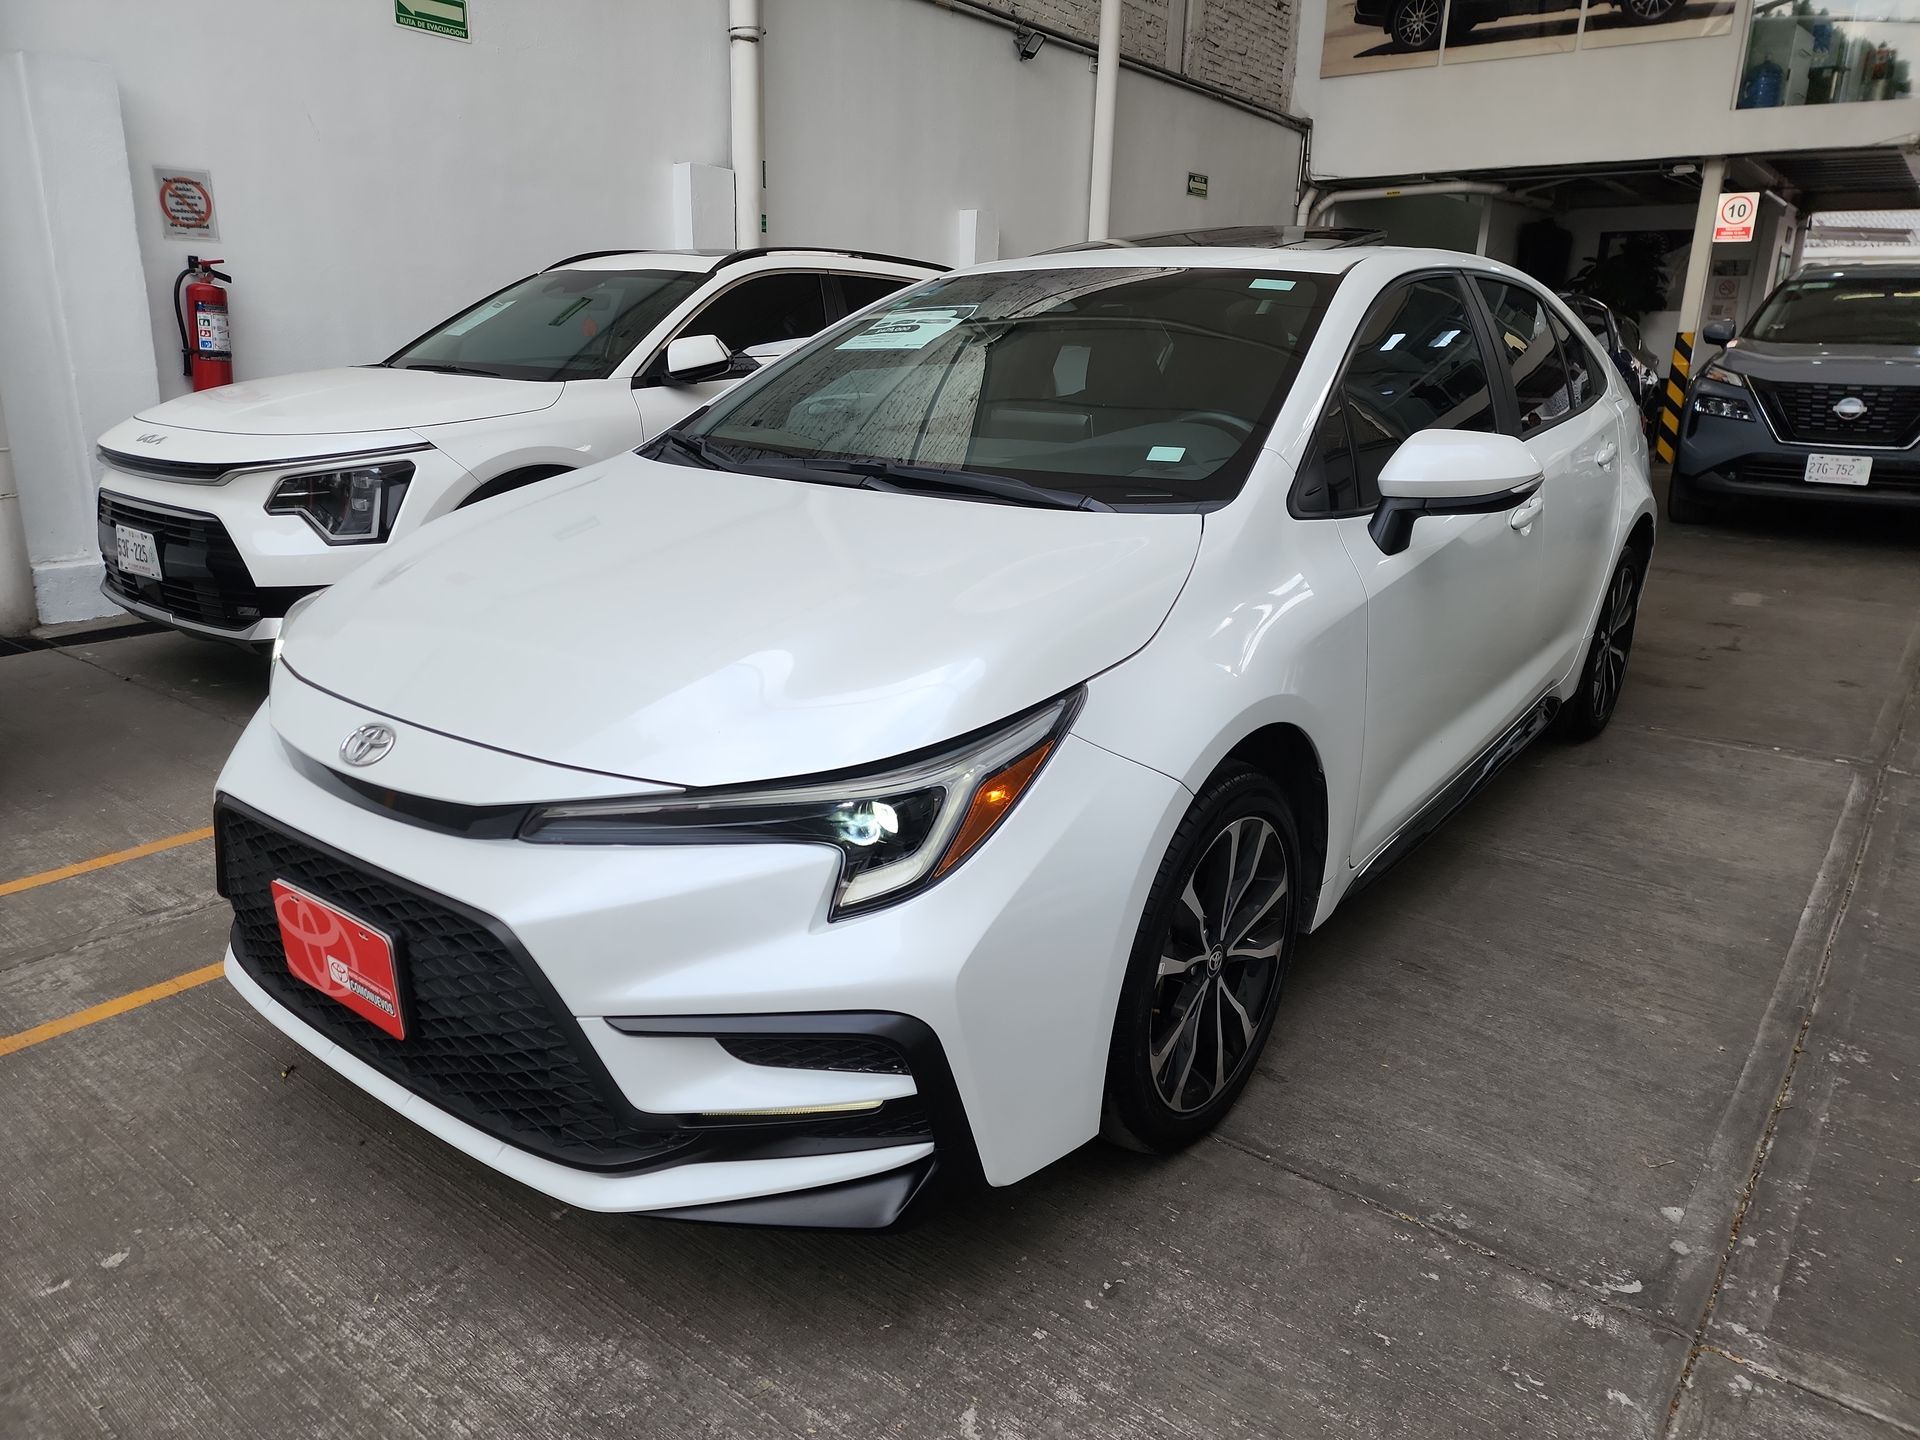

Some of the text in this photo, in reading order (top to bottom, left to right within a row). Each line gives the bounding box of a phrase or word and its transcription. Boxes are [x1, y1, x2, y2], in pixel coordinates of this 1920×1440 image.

[399, 16, 466, 38] RUTA DE EVACUACION
[1729, 204, 1747, 218] 10
[1808, 462, 1856, 477] 27G-752
